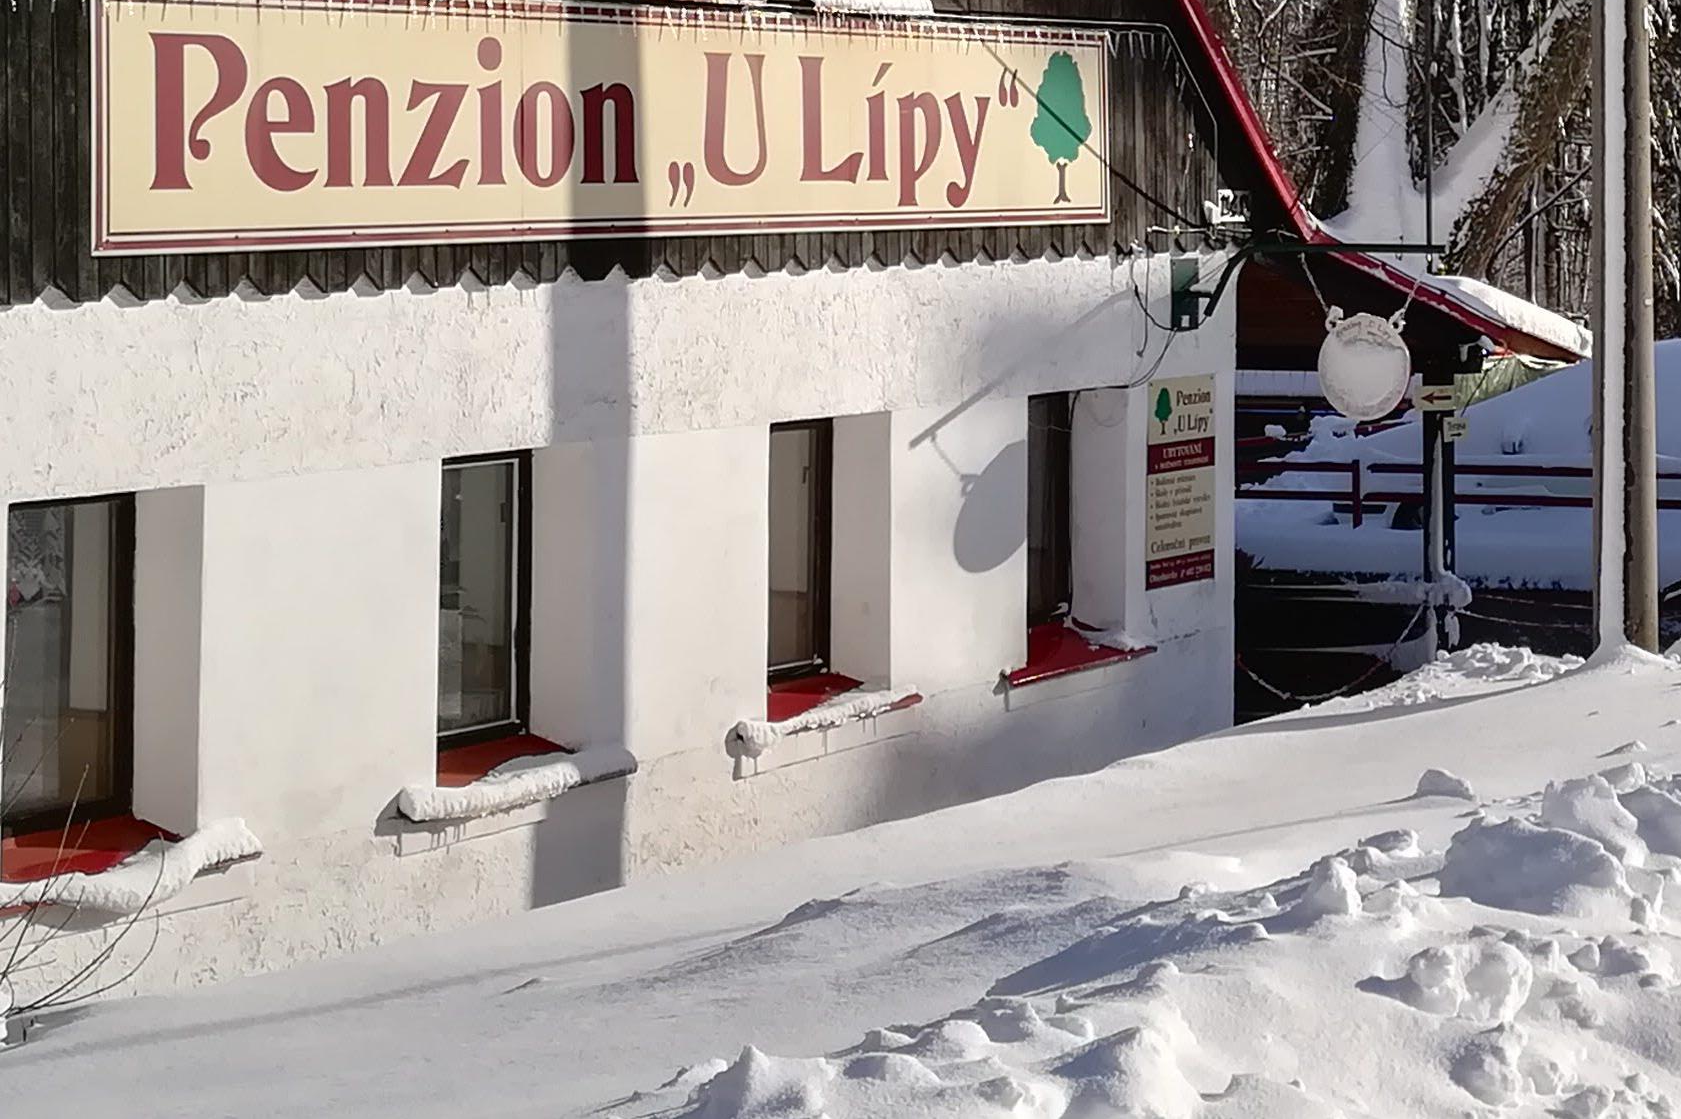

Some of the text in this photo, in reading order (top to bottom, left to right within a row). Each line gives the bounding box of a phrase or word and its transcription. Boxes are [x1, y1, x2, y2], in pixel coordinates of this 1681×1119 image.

[148, 32, 1020, 210] Penzion „U Lípy“
[1176, 388, 1211, 406] Penzion
